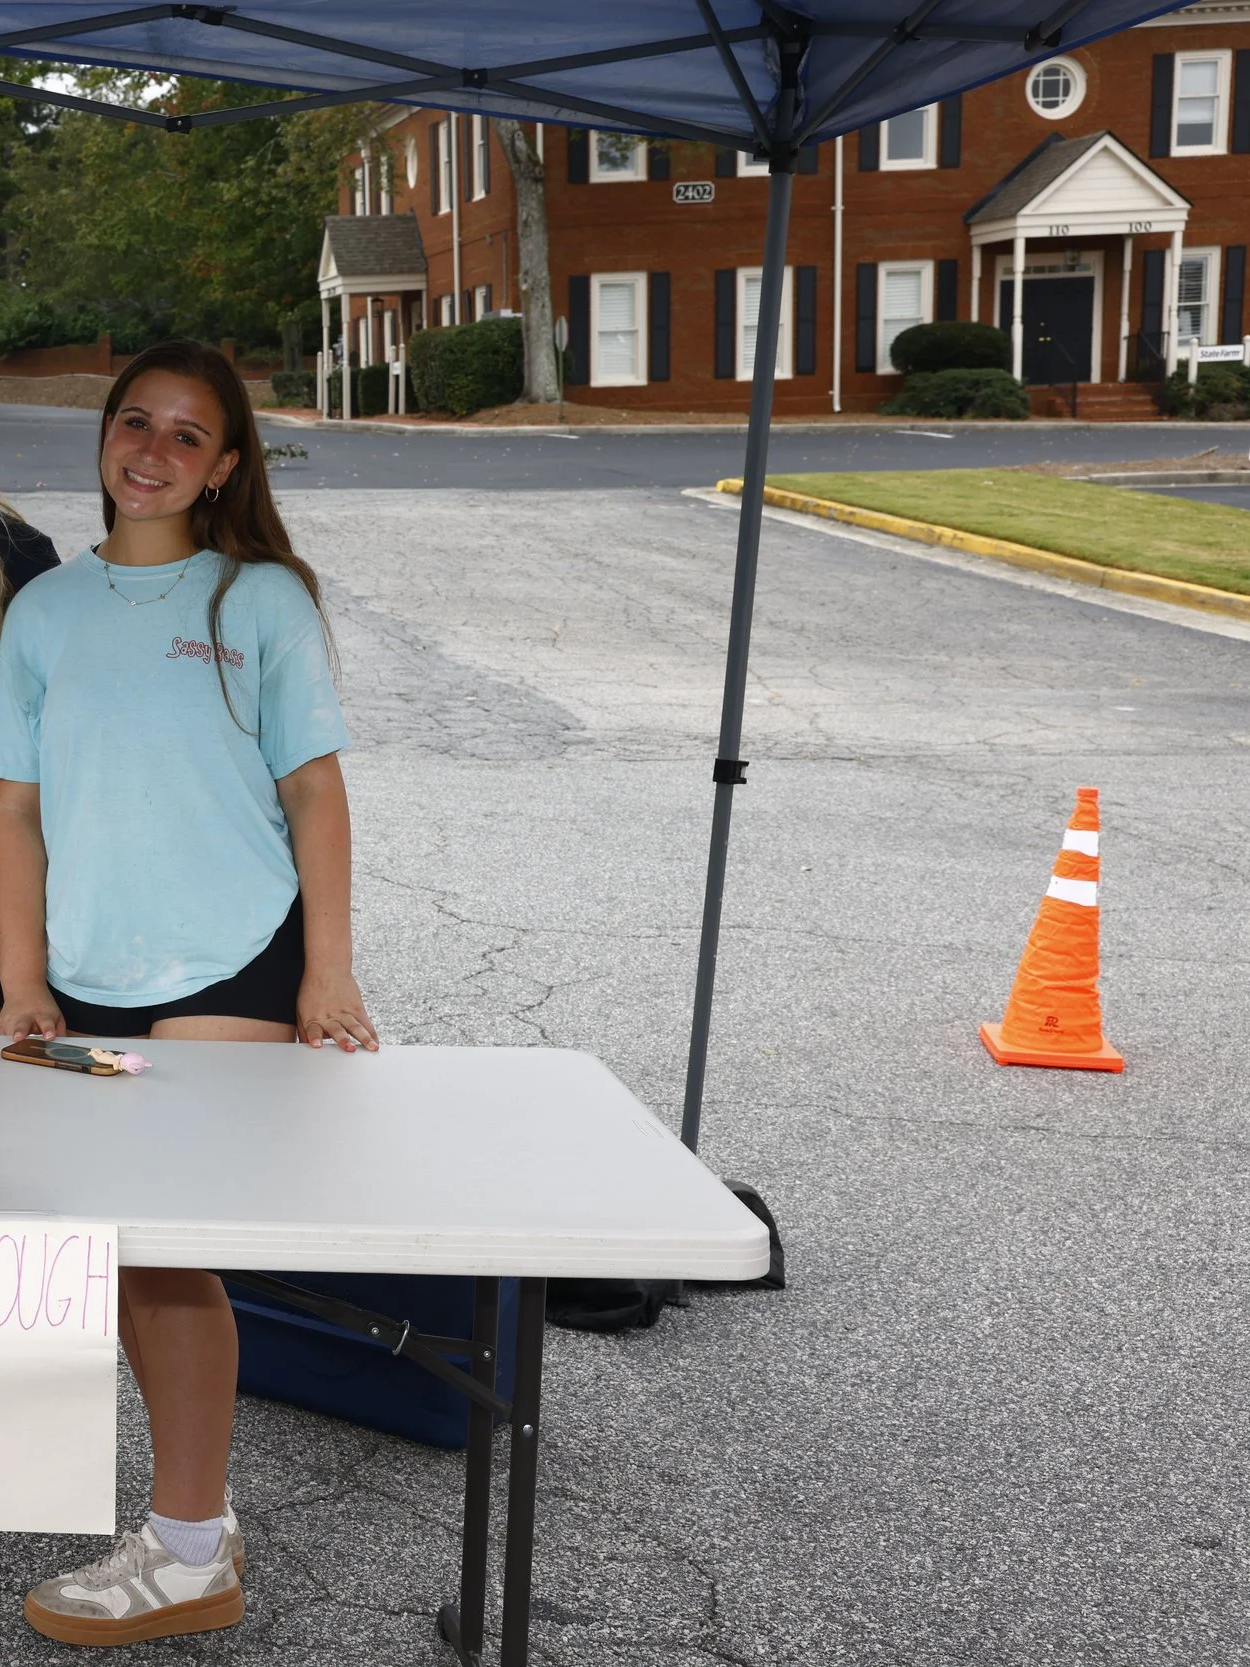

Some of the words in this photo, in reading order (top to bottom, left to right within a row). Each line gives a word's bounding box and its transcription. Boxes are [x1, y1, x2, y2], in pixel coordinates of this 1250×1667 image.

[677, 185, 711, 200] 2402
[1048, 224, 1069, 236] 110
[1128, 221, 1152, 233] 100
[166, 636, 212, 665] Sassy
